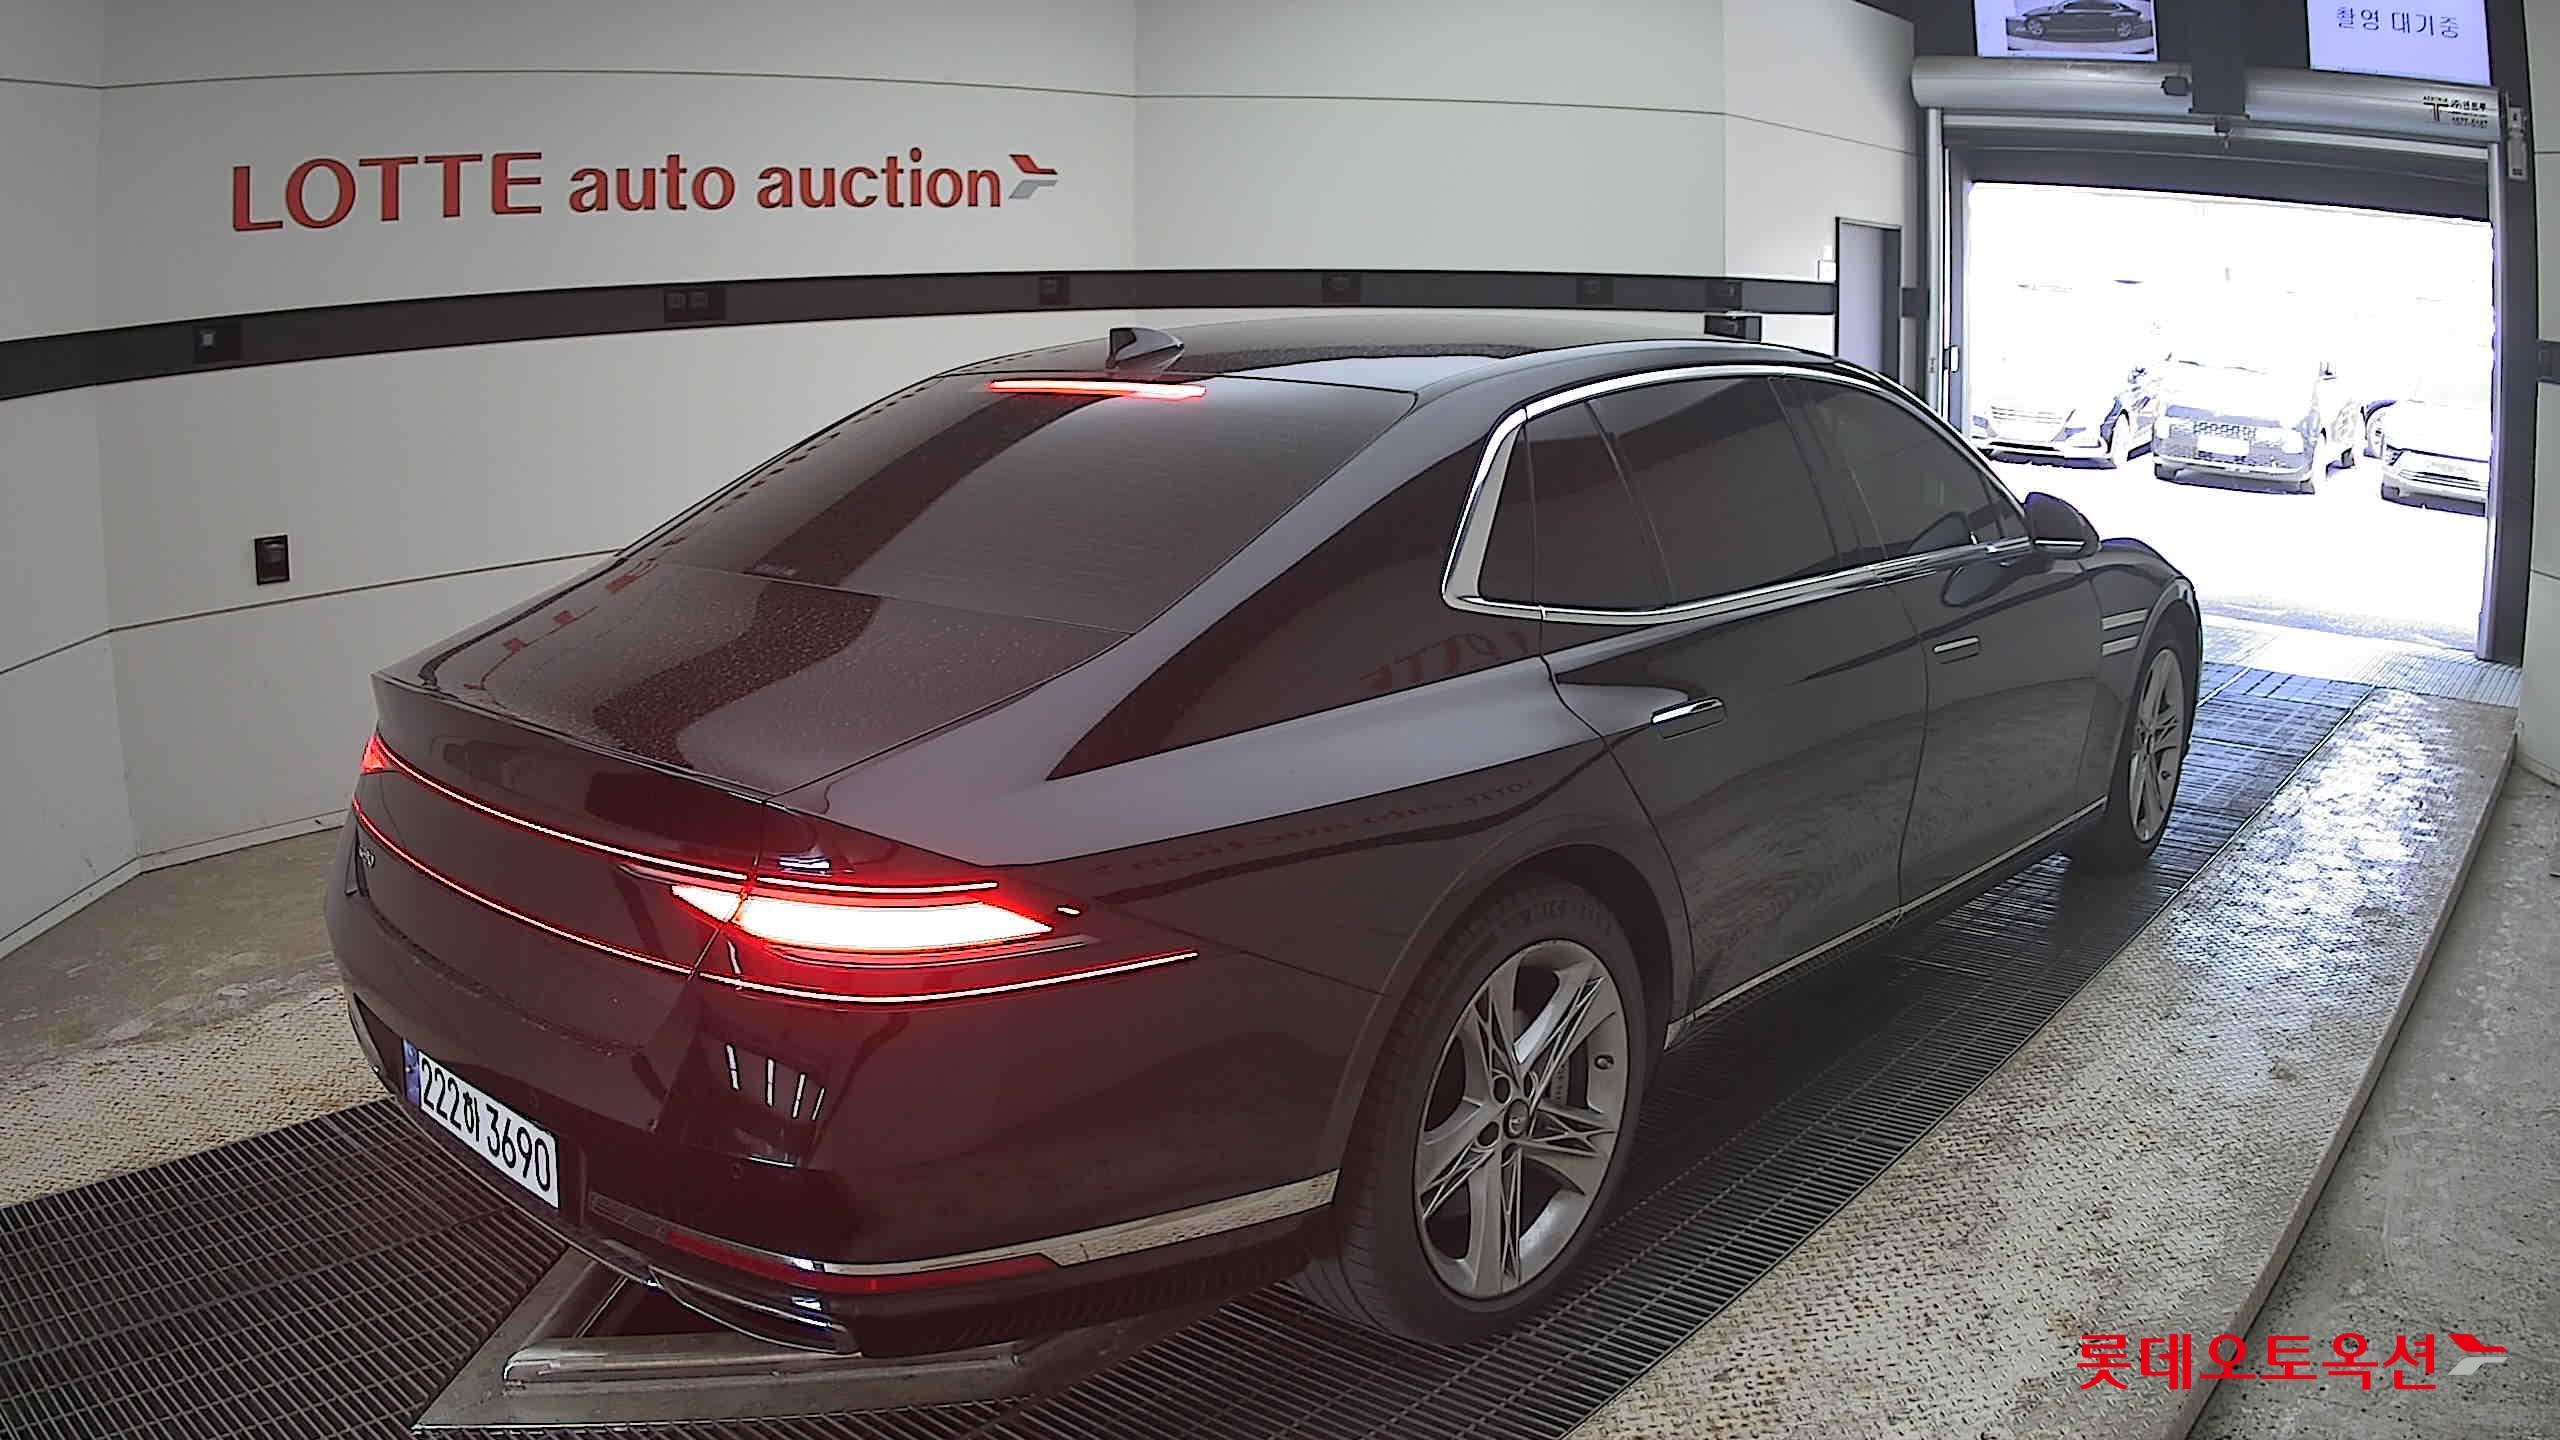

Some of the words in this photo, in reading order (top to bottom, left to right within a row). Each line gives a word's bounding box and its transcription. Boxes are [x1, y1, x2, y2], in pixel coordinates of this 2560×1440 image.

[2336, 7, 2381, 32] 촬영
[2390, 11, 2459, 39] 대기중
[234, 152, 543, 232] LOTTE
[568, 154, 736, 212] auto
[757, 147, 1003, 209] auction
[485, 1102, 551, 1193] 3690
